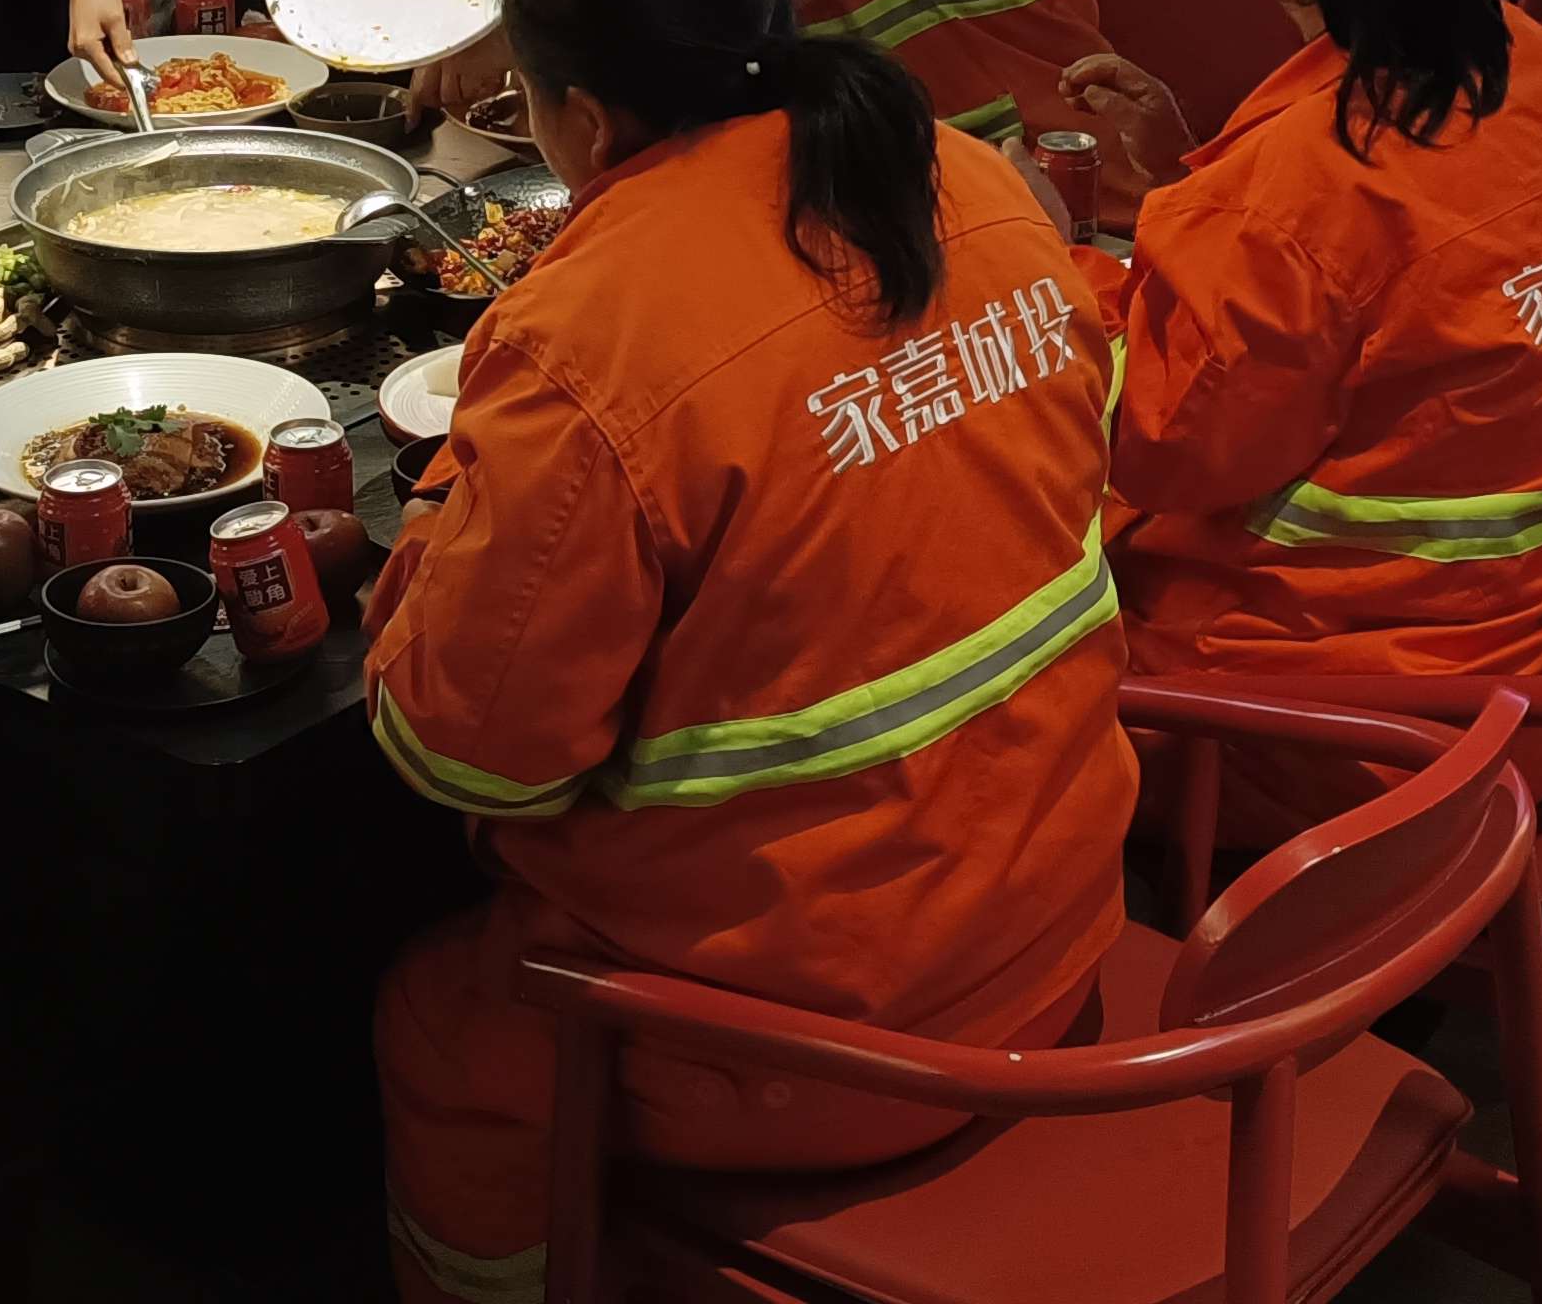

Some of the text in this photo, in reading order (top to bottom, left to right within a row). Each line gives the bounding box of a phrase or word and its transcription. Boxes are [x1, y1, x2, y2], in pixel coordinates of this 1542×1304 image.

[806, 276, 1076, 475] 家嘉城投
[239, 564, 281, 588] 爱上
